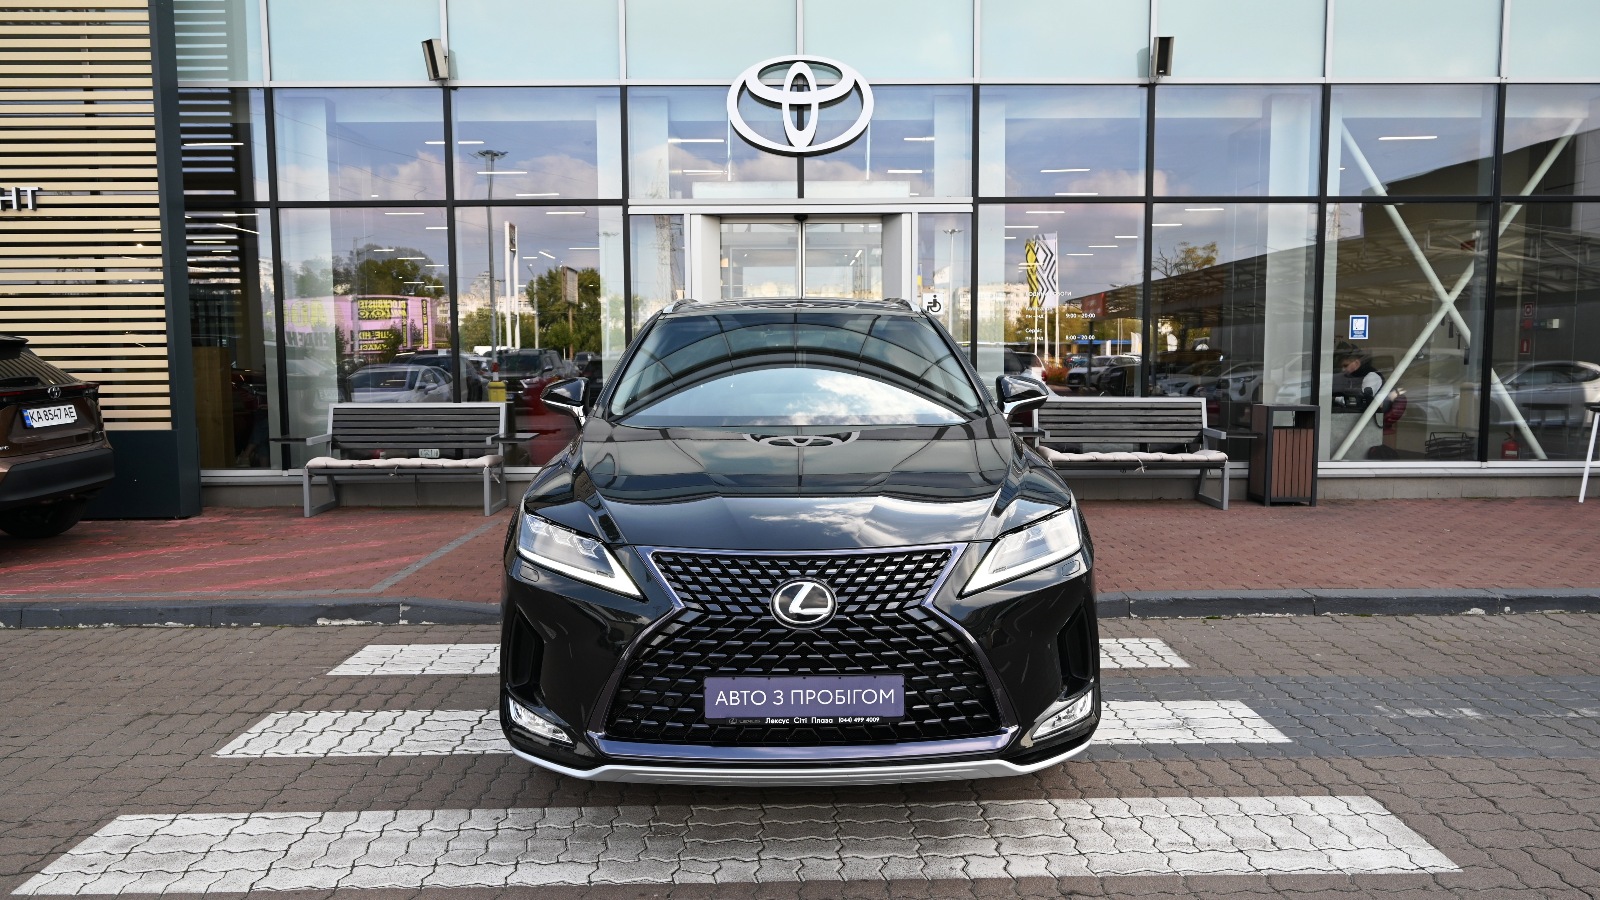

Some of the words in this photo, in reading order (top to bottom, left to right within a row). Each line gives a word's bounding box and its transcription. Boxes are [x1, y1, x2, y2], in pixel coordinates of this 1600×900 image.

[29, 410, 43, 423] KA
[44, 408, 63, 421] 8547
[64, 406, 76, 419] AE
[715, 690, 767, 706] АВТО
[772, 689, 784, 706] З
[790, 688, 895, 705] ПРОБІГОМ
[764, 717, 790, 725] Лексус
[793, 716, 808, 724] Сіті
